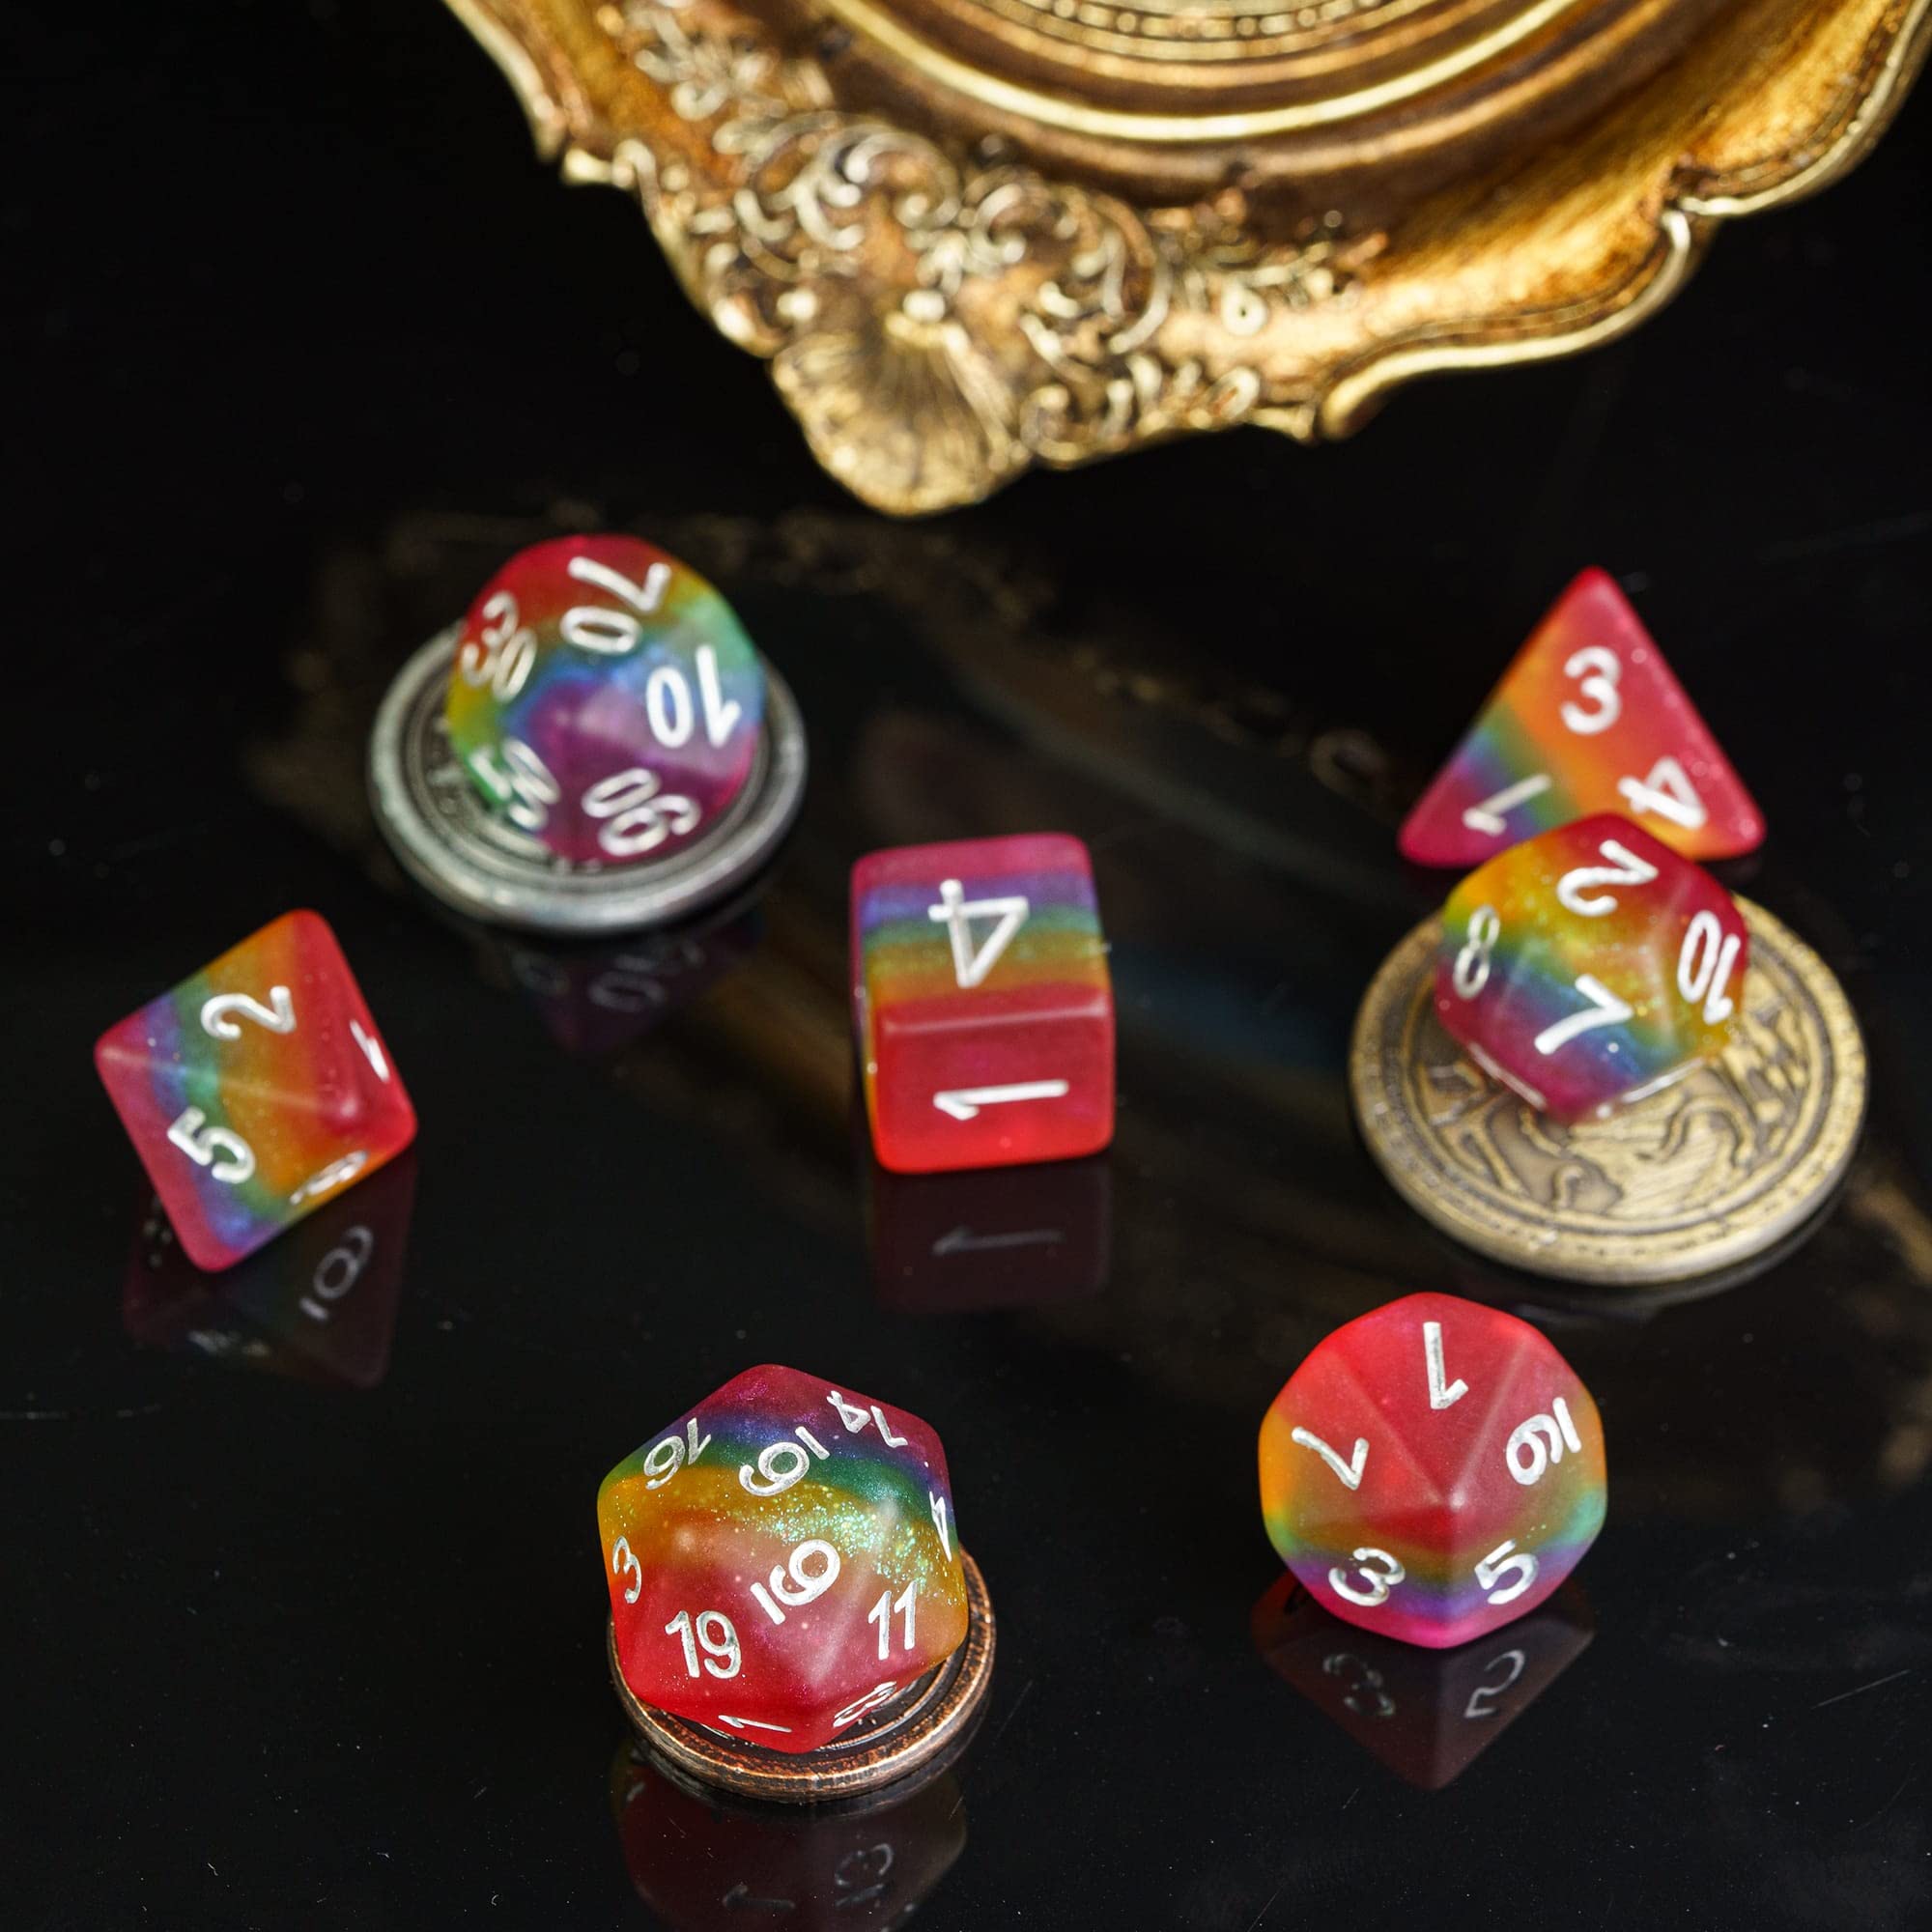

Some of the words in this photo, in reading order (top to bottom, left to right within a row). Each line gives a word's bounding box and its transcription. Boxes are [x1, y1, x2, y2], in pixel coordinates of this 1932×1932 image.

[559, 556, 672, 653] 70
[645, 644, 742, 748] 10
[1560, 645, 1623, 735] 3
[1462, 772, 1552, 837] 1
[1617, 756, 1707, 831] 4
[1556, 839, 1660, 918] 2
[927, 878, 1030, 989] 4
[1452, 904, 1501, 1000] 8
[1677, 910, 1741, 1025] 10
[200, 985, 296, 1040] 2
[1534, 973, 1634, 1056] 7
[932, 1078, 1070, 1121] 1
[167, 1106, 256, 1183] 5
[1423, 1321, 1469, 1409] 1
[643, 1417, 712, 1491] 16
[826, 1390, 908, 1449] 14
[1291, 1426, 1370, 1491] 7
[928, 1491, 952, 1562] 4
[611, 1535, 642, 1605] 3
[1327, 1547, 1406, 1606] 3
[1473, 1539, 1540, 1605] 5
[665, 1609, 743, 1679] 19
[867, 1580, 919, 1661] 11
